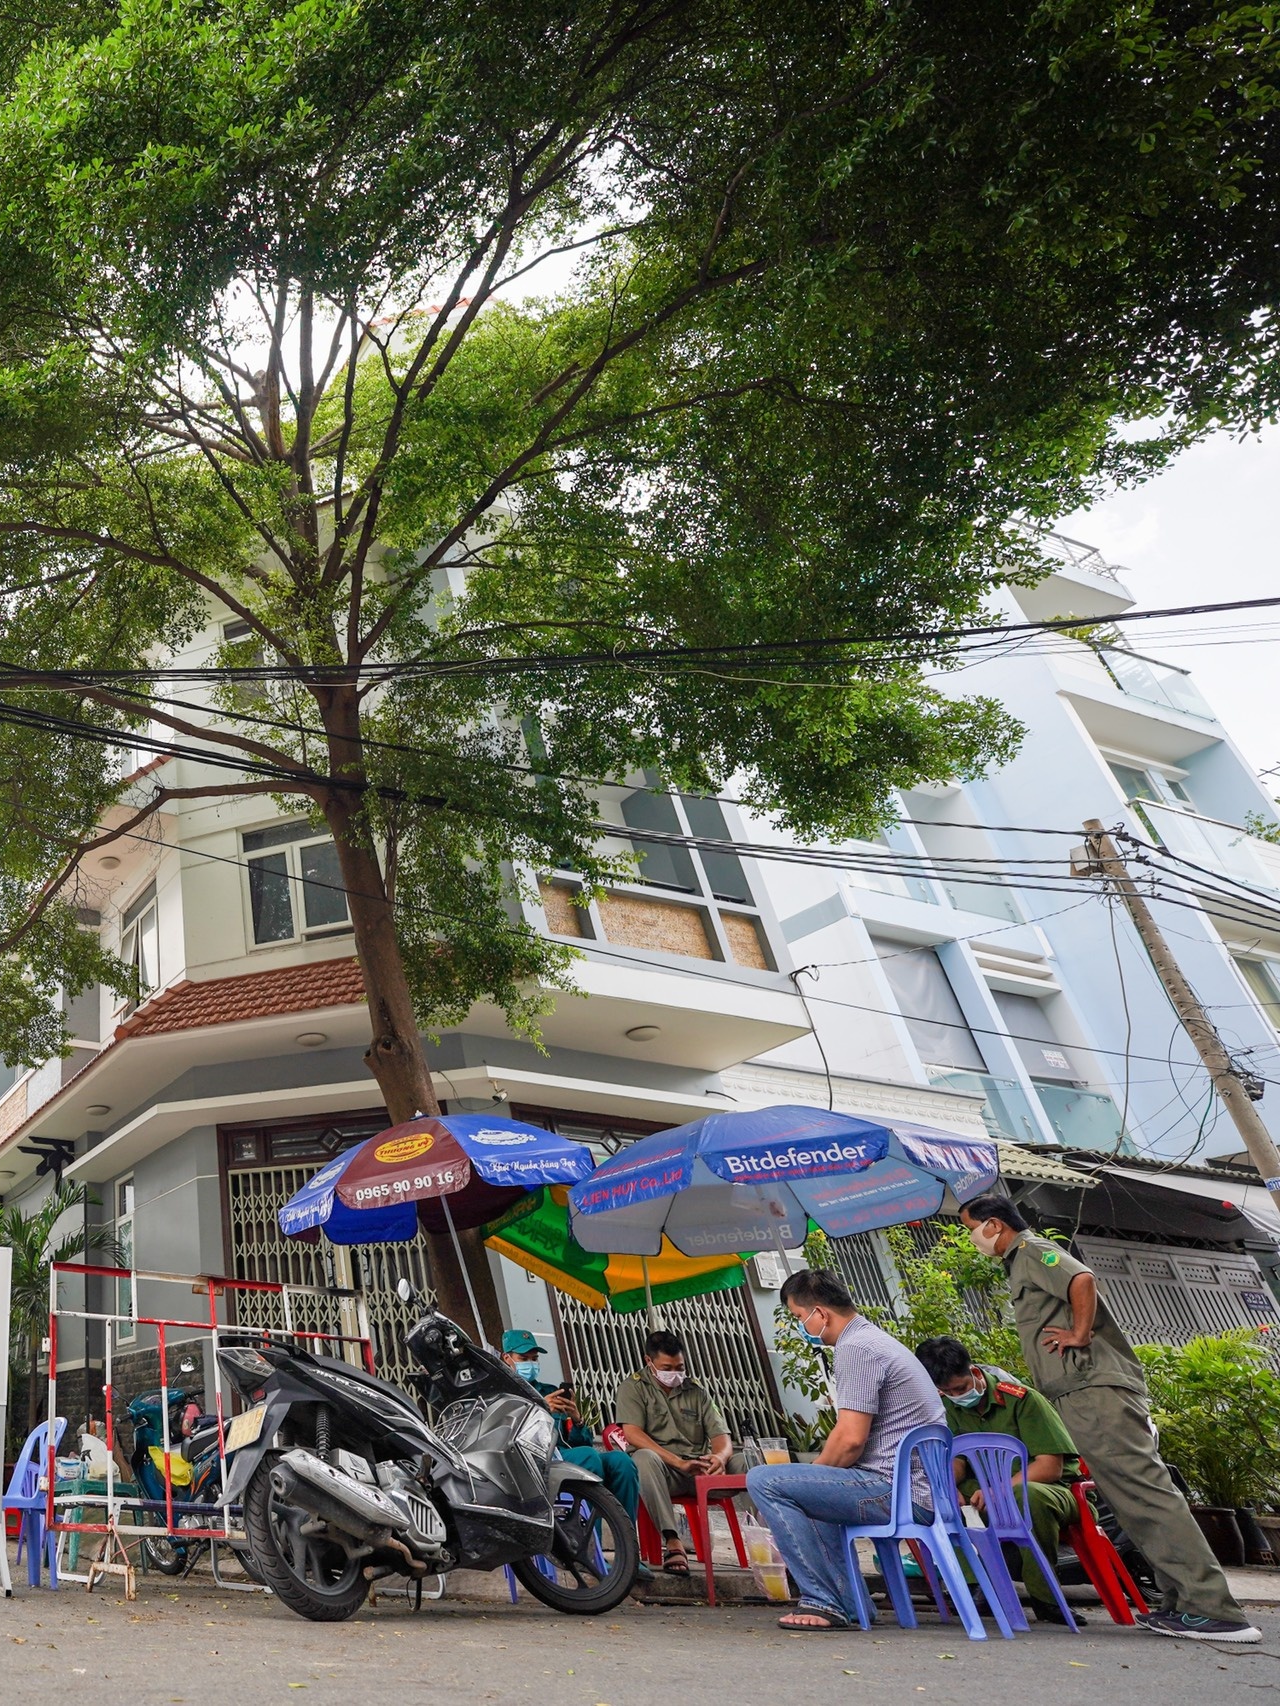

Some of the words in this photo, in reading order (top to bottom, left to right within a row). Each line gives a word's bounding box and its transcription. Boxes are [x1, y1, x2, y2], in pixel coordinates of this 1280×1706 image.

[724, 1142, 867, 1174] Bitdefender
[355, 1184, 390, 1201] 0965
[393, 1180, 411, 1193] 90
[414, 1175, 432, 1189] 90
[436, 1171, 454, 1185] 16
[583, 1190, 609, 1206] LIEN
[611, 1181, 637, 1197] HUY
